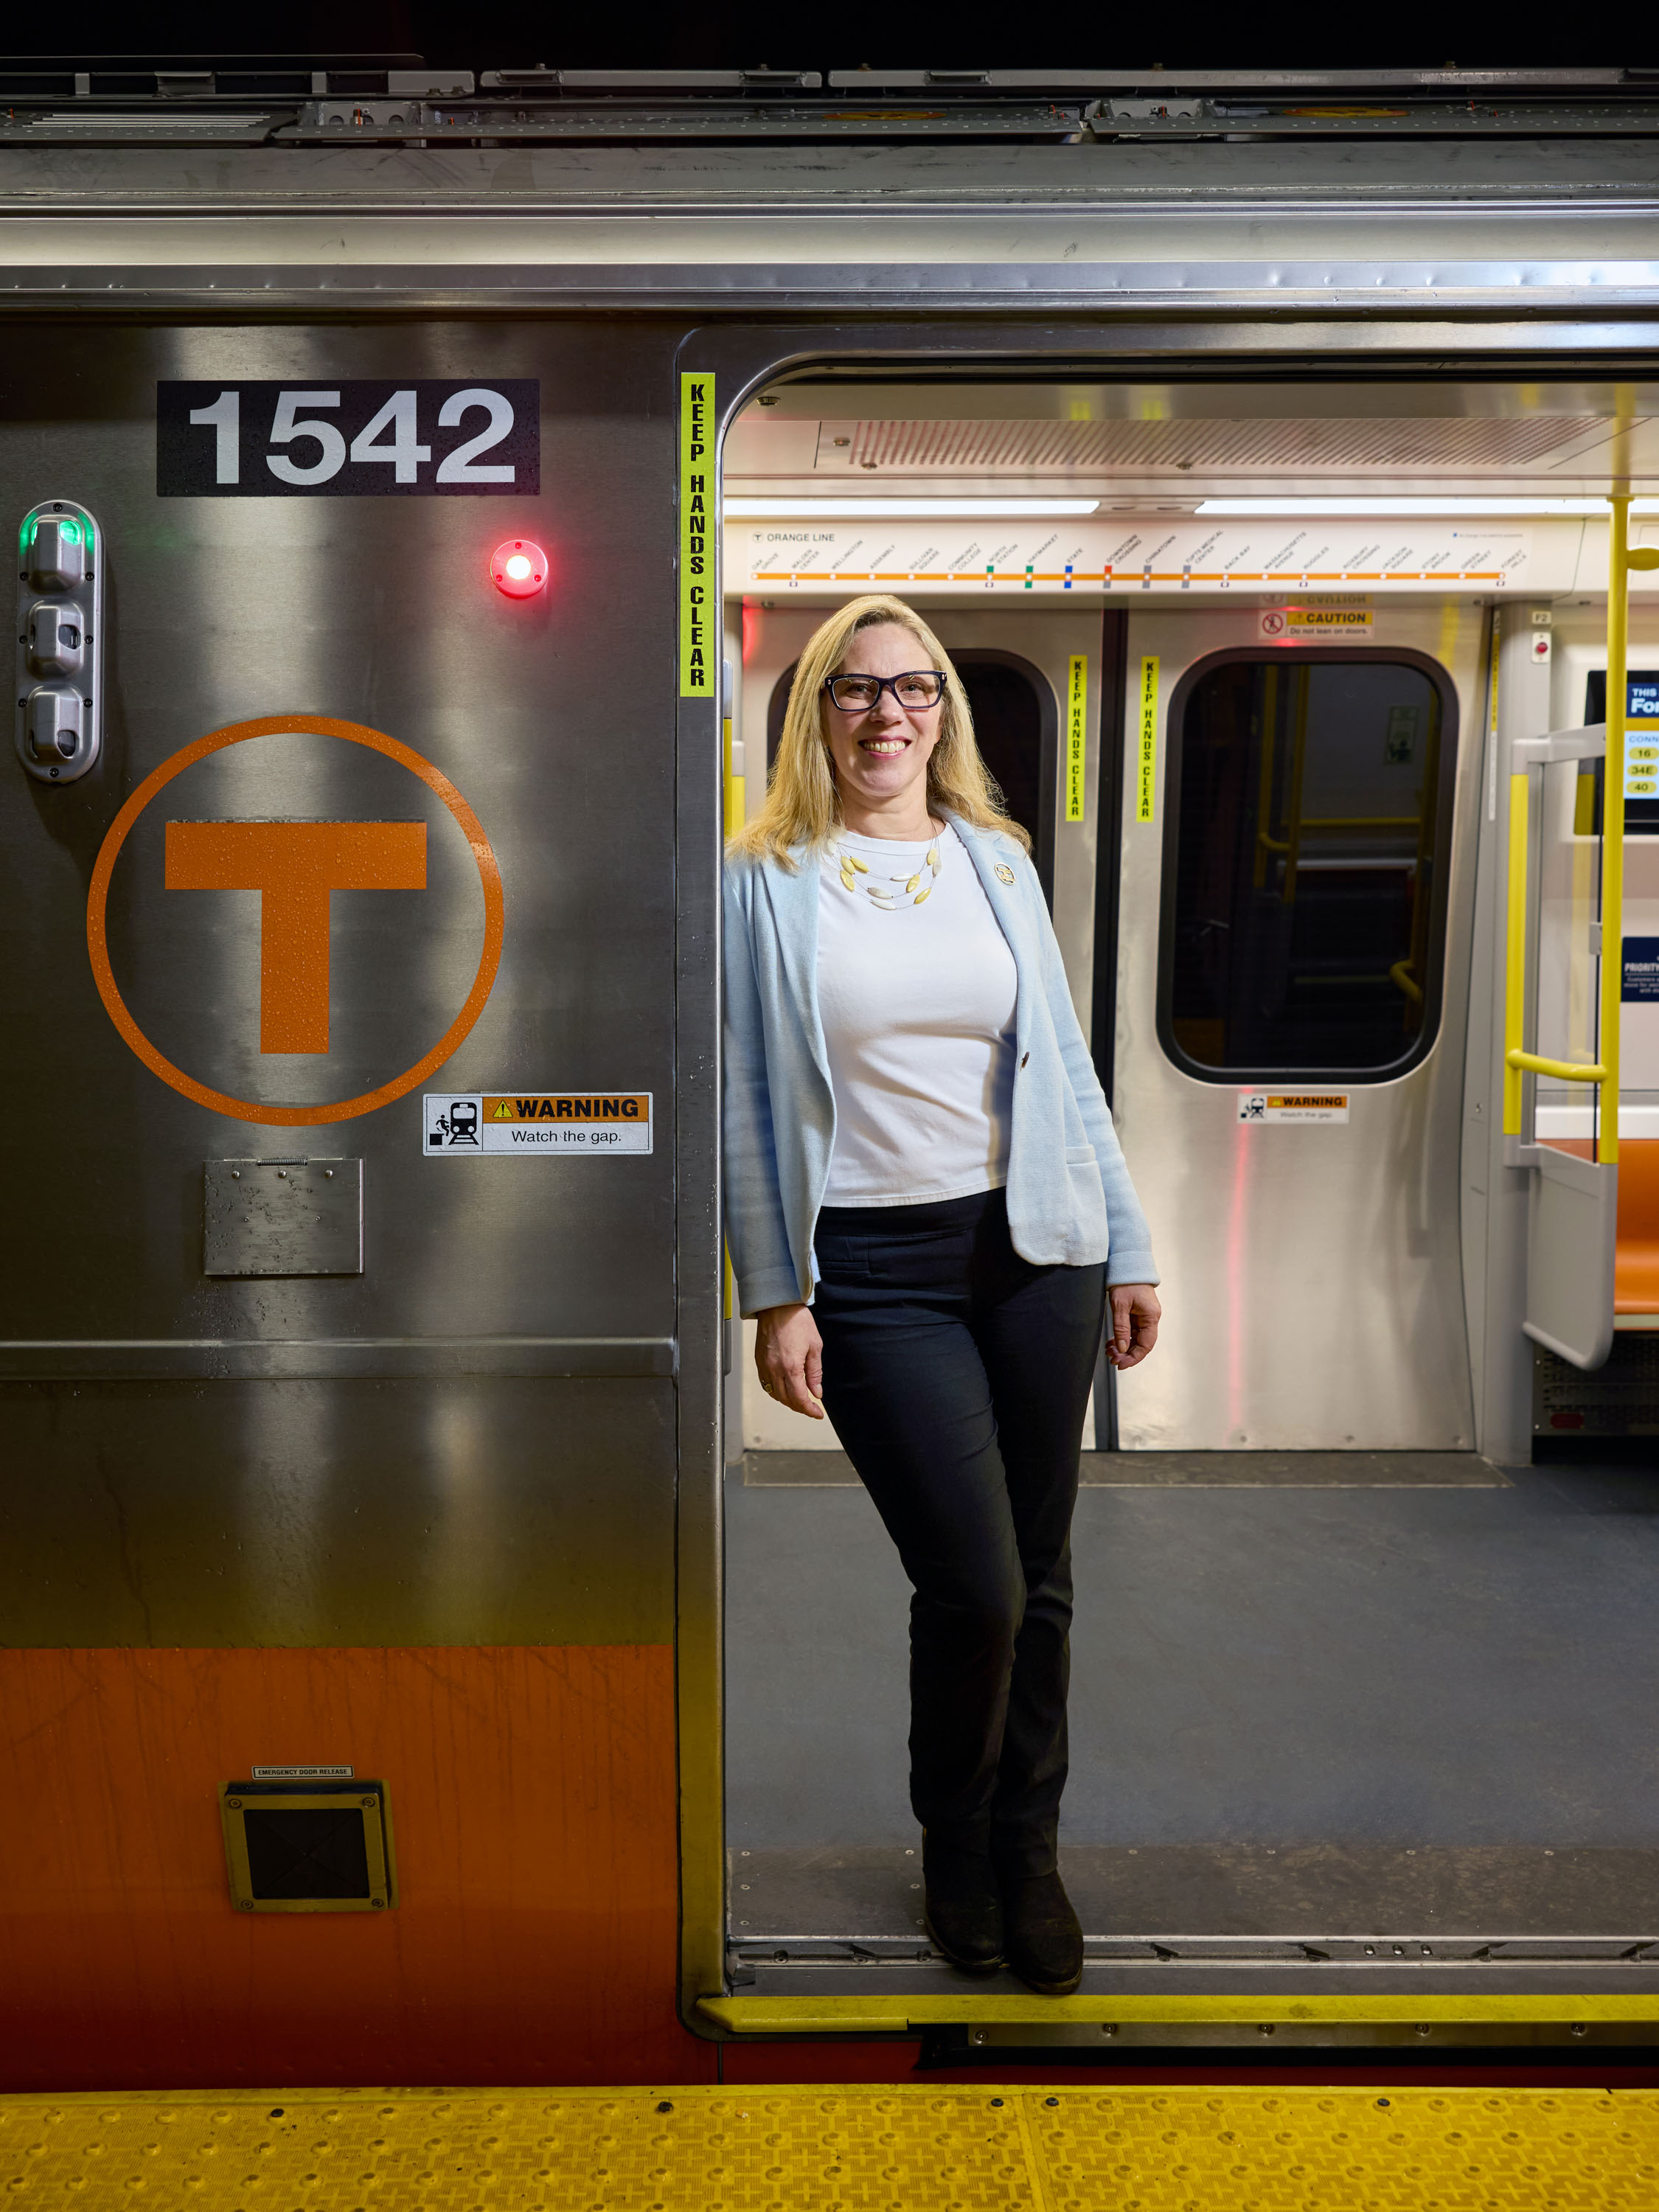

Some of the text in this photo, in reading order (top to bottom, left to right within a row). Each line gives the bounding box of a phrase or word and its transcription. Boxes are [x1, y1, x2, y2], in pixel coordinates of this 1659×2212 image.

[189, 388, 515, 485] 1542
[689, 384, 705, 686] KEEP HANDS CLEAR
[767, 533, 810, 542] ORANGE
[813, 533, 835, 542] LINE
[832, 540, 863, 570] WELLINGTON
[948, 542, 978, 571] COMMUNITY
[989, 546, 1006, 563] NORTH
[997, 543, 1019, 564] STATION
[1028, 534, 1059, 563] HAYMARKET
[1066, 548, 1083, 563] STATE
[1107, 534, 1138, 563] DOWNTOWN
[1115, 538, 1142, 564] CROSSING
[1145, 535, 1176, 563] CHINATOWN
[1186, 530, 1223, 563] TUFTS MEDICAL
[1194, 546, 1215, 564] CENTER
[762, 553, 779, 570] GROVE
[791, 549, 813, 569] MALDEN
[799, 551, 821, 571] CENTER
[869, 544, 896, 570] ASSEMBLY
[957, 548, 982, 571] COLLEGE
[1224, 546, 1251, 570] BACK BAY
[1307, 613, 1366, 623] CAUTION
[1535, 613, 1548, 622] F2
[1632, 688, 1657, 697] THIS
[1071, 661, 1082, 815] KEEP HANDS CLEAR
[1141, 662, 1154, 817] KEEP HANDS CLEAR
[1639, 749, 1651, 757] 16
[1632, 766, 1653, 774] 34E
[1634, 783, 1649, 791] 40
[165, 822, 427, 1054] T
[516, 1099, 639, 1119] WARNING
[1283, 1096, 1343, 1107] WARNING
[512, 1130, 622, 1144] Watch the gap.
